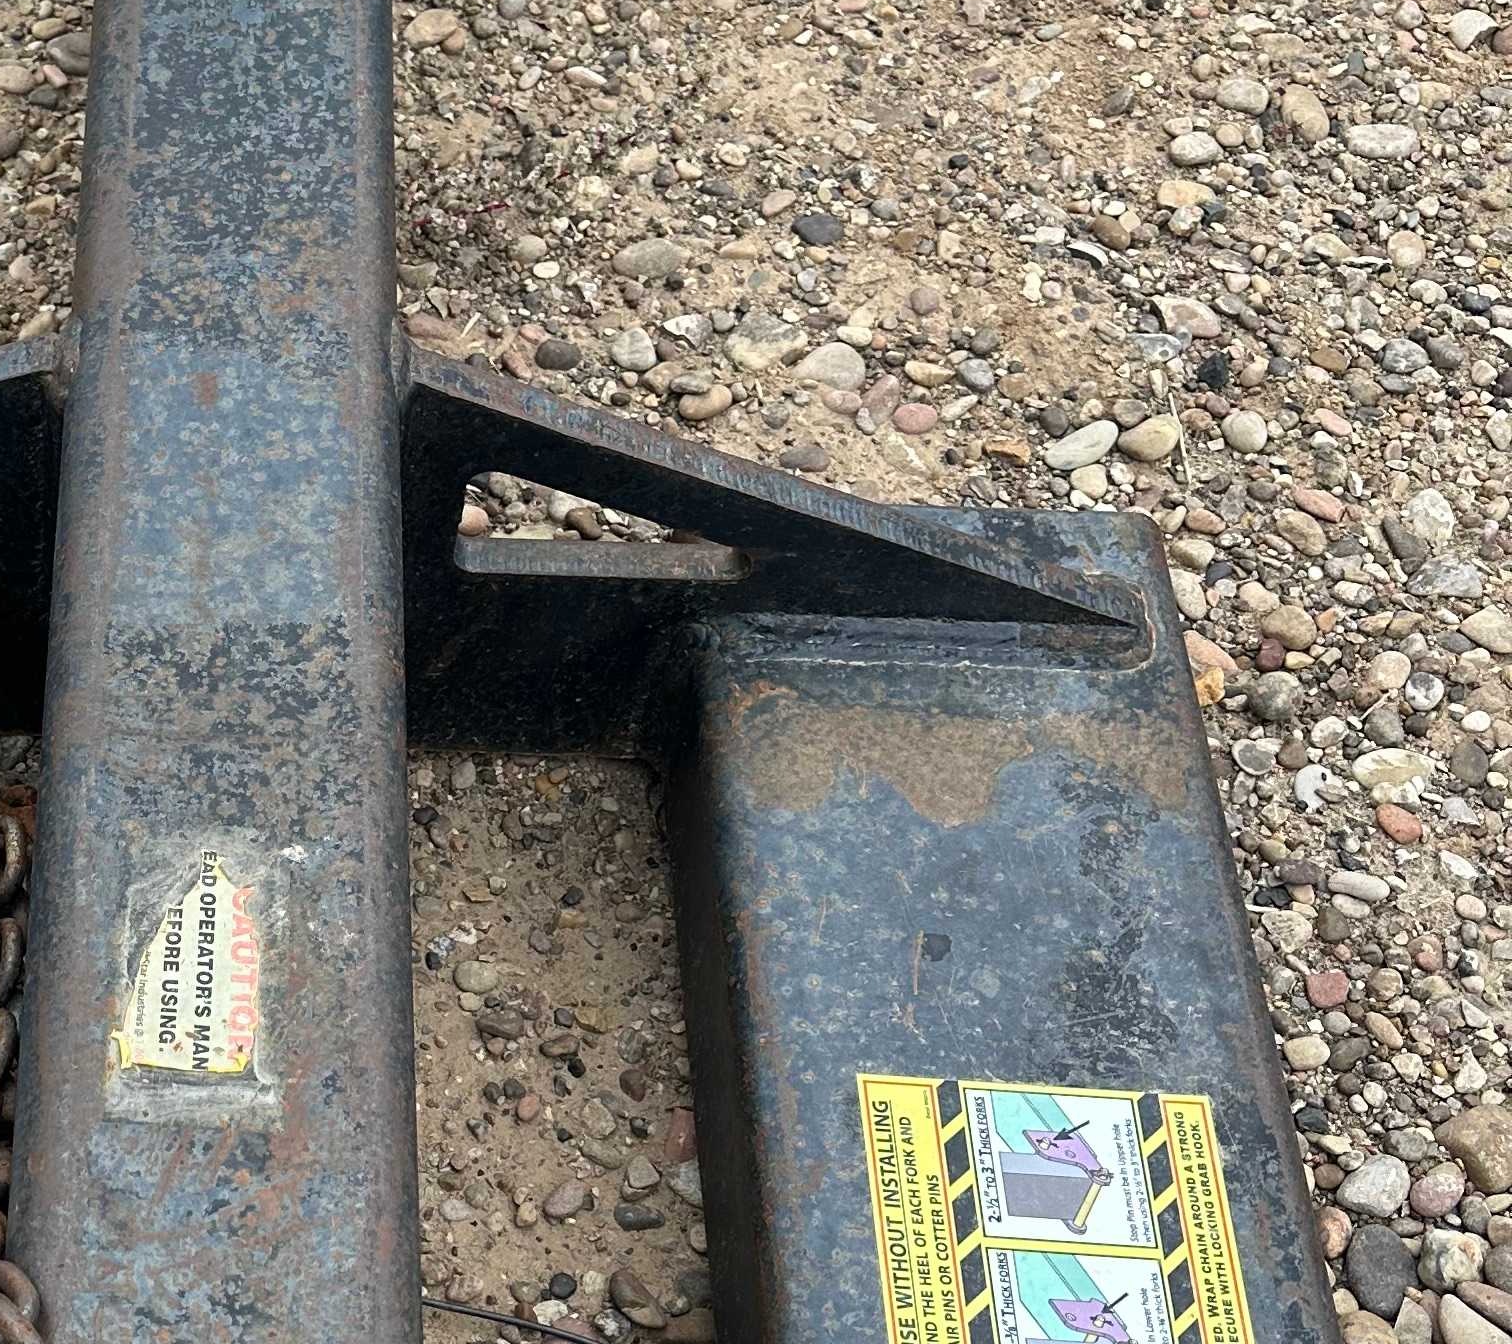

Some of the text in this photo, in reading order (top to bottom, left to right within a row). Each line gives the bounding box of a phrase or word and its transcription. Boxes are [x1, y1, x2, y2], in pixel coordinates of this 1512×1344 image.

[158, 902, 183, 1052] EFORE USING.
[898, 1115, 914, 1145] AND
[1173, 1110, 1192, 1161] STRONG
[871, 1100, 901, 1208] INSTALLING
[902, 1148, 919, 1184] FORK
[1183, 1164, 1194, 1173] A
[925, 1174, 942, 1205] PINS
[1196, 1162, 1212, 1196] GRAB
[907, 1188, 924, 1224] EACH
[1185, 1176, 1204, 1230] AROUND
[912, 1228, 927, 1247] OF
[930, 1208, 949, 1261] COTTER
[1203, 1200, 1224, 1257] LOCKING
[885, 1215, 913, 1309] WITHOUT
[915, 1251, 932, 1286] HEEL
[1195, 1233, 1212, 1274] CHAIN
[937, 1264, 952, 1285] OR
[1214, 1261, 1230, 1295] WITH
[920, 1290, 936, 1317] THE
[940, 1289, 957, 1321] PINS
[1203, 1277, 1220, 1318] WRAP
